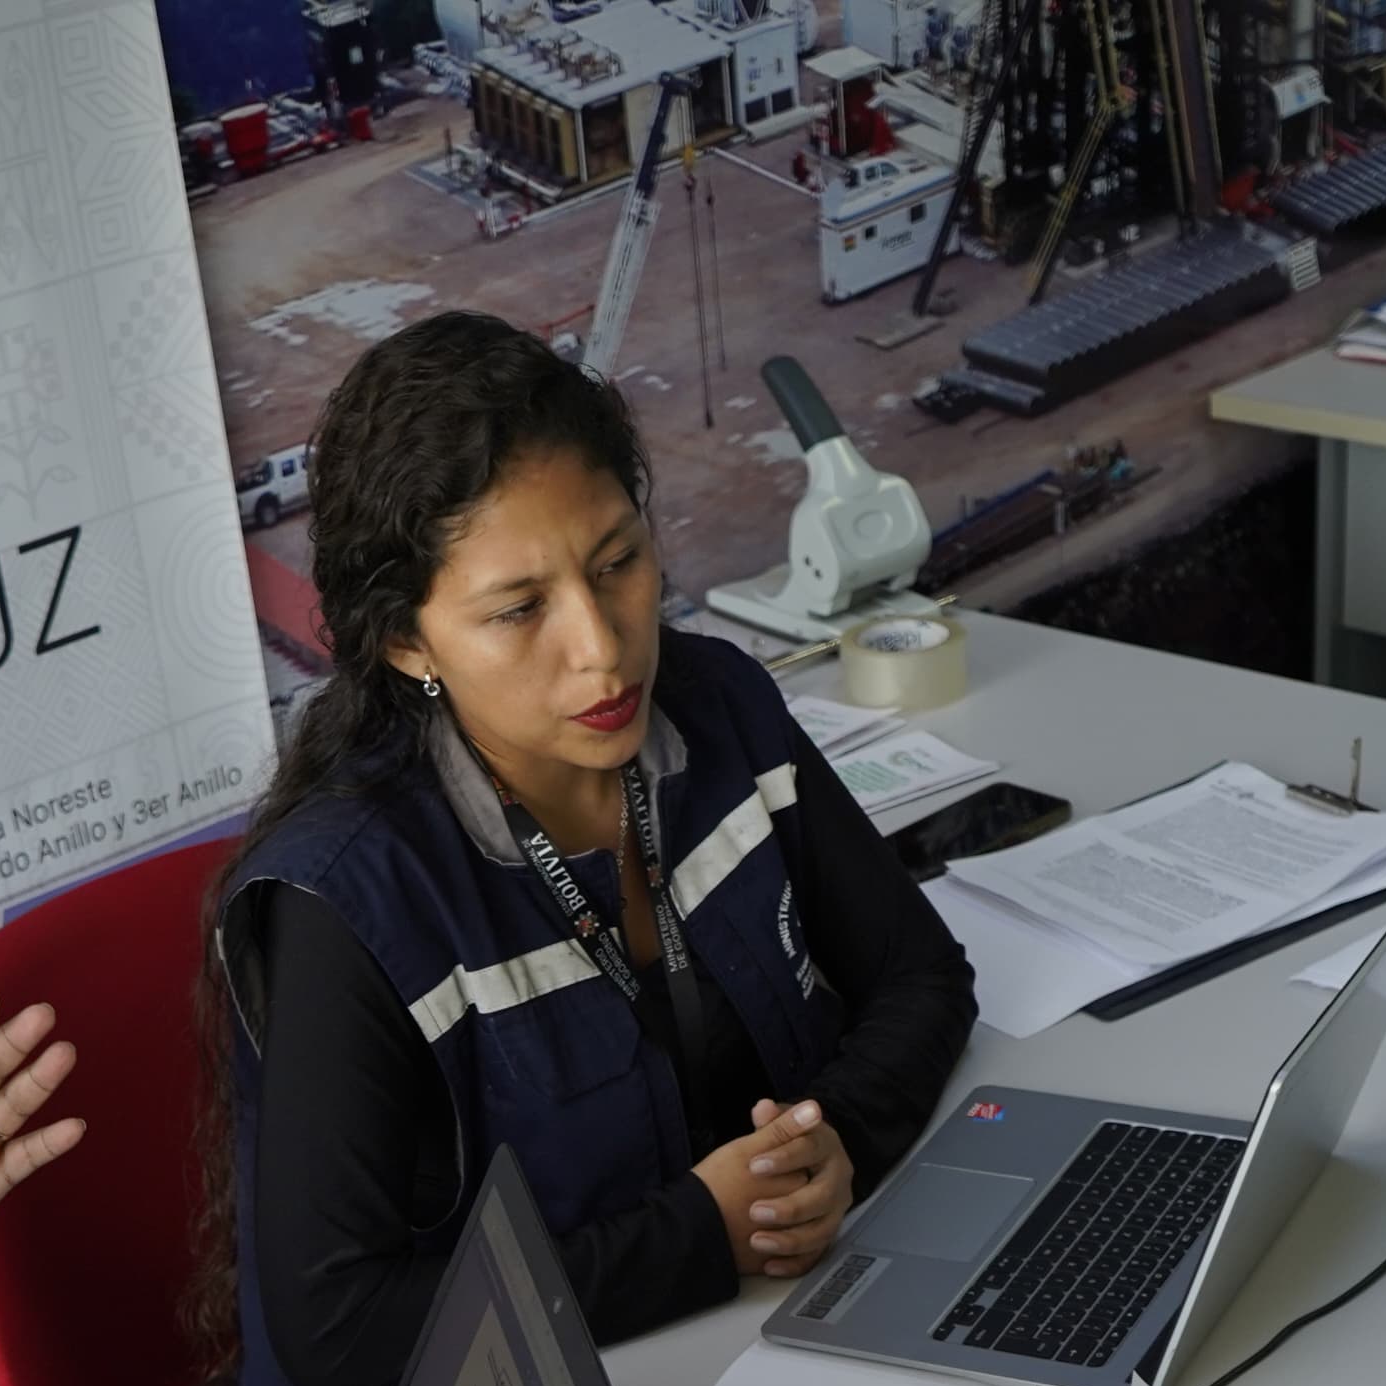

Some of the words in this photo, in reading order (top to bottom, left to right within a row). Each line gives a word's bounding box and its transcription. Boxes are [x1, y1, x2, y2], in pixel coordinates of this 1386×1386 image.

[13, 779, 111, 831] Noreste
[39, 822, 106, 864] Anillo
[115, 820, 124, 840] y
[133, 795, 169, 825] 3er
[178, 767, 241, 807] Anillo
[528, 829, 587, 912] BOLIVIA
[597, 930, 632, 979] GOBIERNO
[654, 903, 678, 973] MINISTERIO
[675, 952, 687, 969] DE
[593, 945, 638, 1002] MINISTERIO
